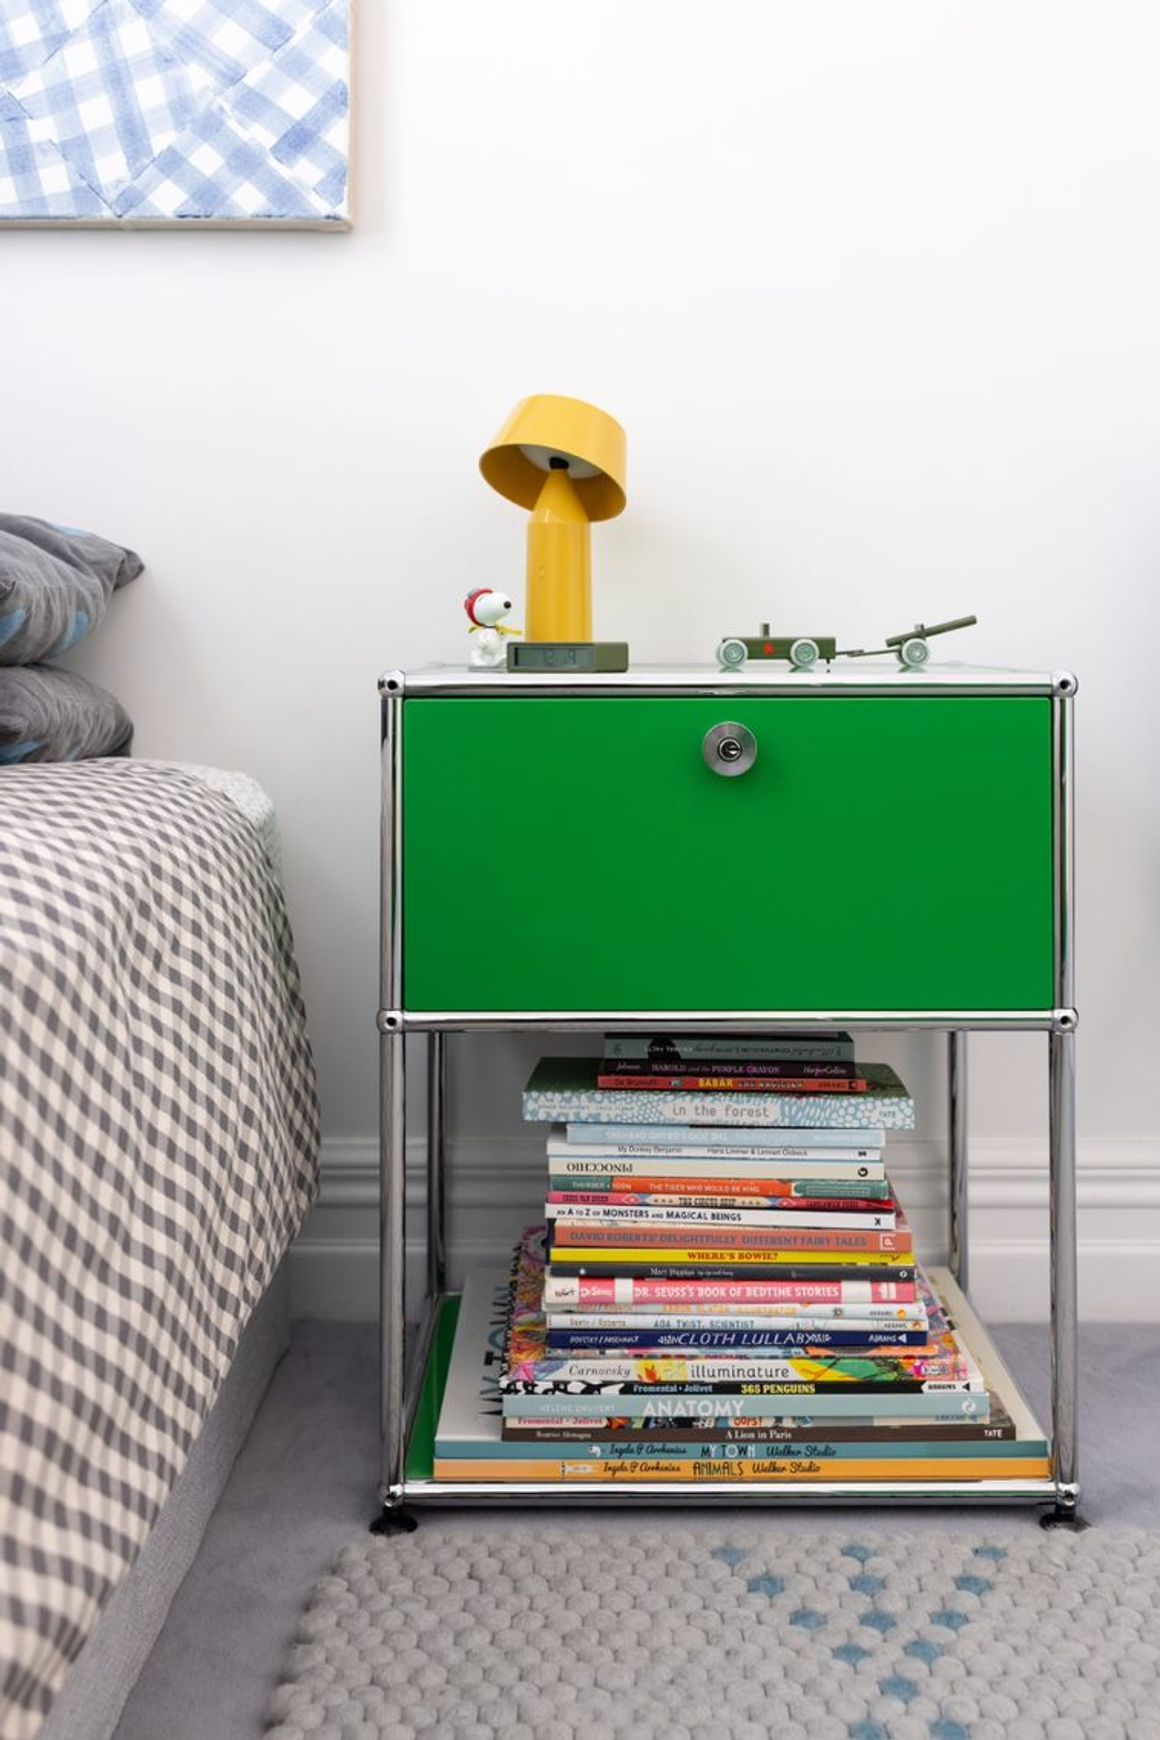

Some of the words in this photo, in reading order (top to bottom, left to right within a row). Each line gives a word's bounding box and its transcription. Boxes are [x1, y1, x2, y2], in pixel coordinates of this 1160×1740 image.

[672, 1104, 687, 1116] in
[694, 1105, 717, 1117] the
[724, 1105, 770, 1118] forest
[566, 1162, 634, 1173] PINOCCHIO
[649, 1183, 663, 1191] THE
[585, 1208, 591, 1216] Z
[602, 1208, 649, 1218] MONSTERS
[665, 1210, 708, 1220] MAGICAL
[711, 1212, 742, 1221] BEINGS
[570, 1231, 605, 1242] DAVID
[659, 1233, 737, 1244] DELIGHTFULLY
[742, 1235, 797, 1246] DIFFERENT
[801, 1236, 831, 1246] FAIRY
[836, 1236, 868, 1247] TALES
[687, 1251, 735, 1260] WHERE'S
[738, 1252, 779, 1261] BOWIE?
[634, 1287, 652, 1298] DR.
[654, 1285, 695, 1298] SEUSS'S
[698, 1286, 727, 1298] BOOK
[728, 1287, 742, 1298] OF
[745, 1286, 794, 1298] BEDTIME
[794, 1286, 839, 1298] STORIES
[679, 1332, 736, 1345] CLOTH
[741, 1332, 814, 1346] LULLABY
[568, 1364, 632, 1378] Carnovsky
[691, 1364, 790, 1378] illuminature
[632, 1383, 678, 1393] Fromental
[740, 1384, 761, 1395] 365
[762, 1383, 816, 1394] PENGUINS
[643, 1399, 745, 1417] ANATOMY
[725, 1430, 733, 1439] A
[734, 1430, 755, 1439] Lion
[757, 1430, 767, 1439] in
[769, 1429, 792, 1440] Paris
[983, 1429, 1003, 1438] TATE
[700, 1444, 718, 1458] MY
[719, 1444, 756, 1458] TOWN
[766, 1444, 802, 1458] Walker
[803, 1444, 838, 1458] Studio
[692, 1461, 744, 1477] ANIMALS
[752, 1461, 788, 1474] Walker
[789, 1461, 822, 1474] Studio
